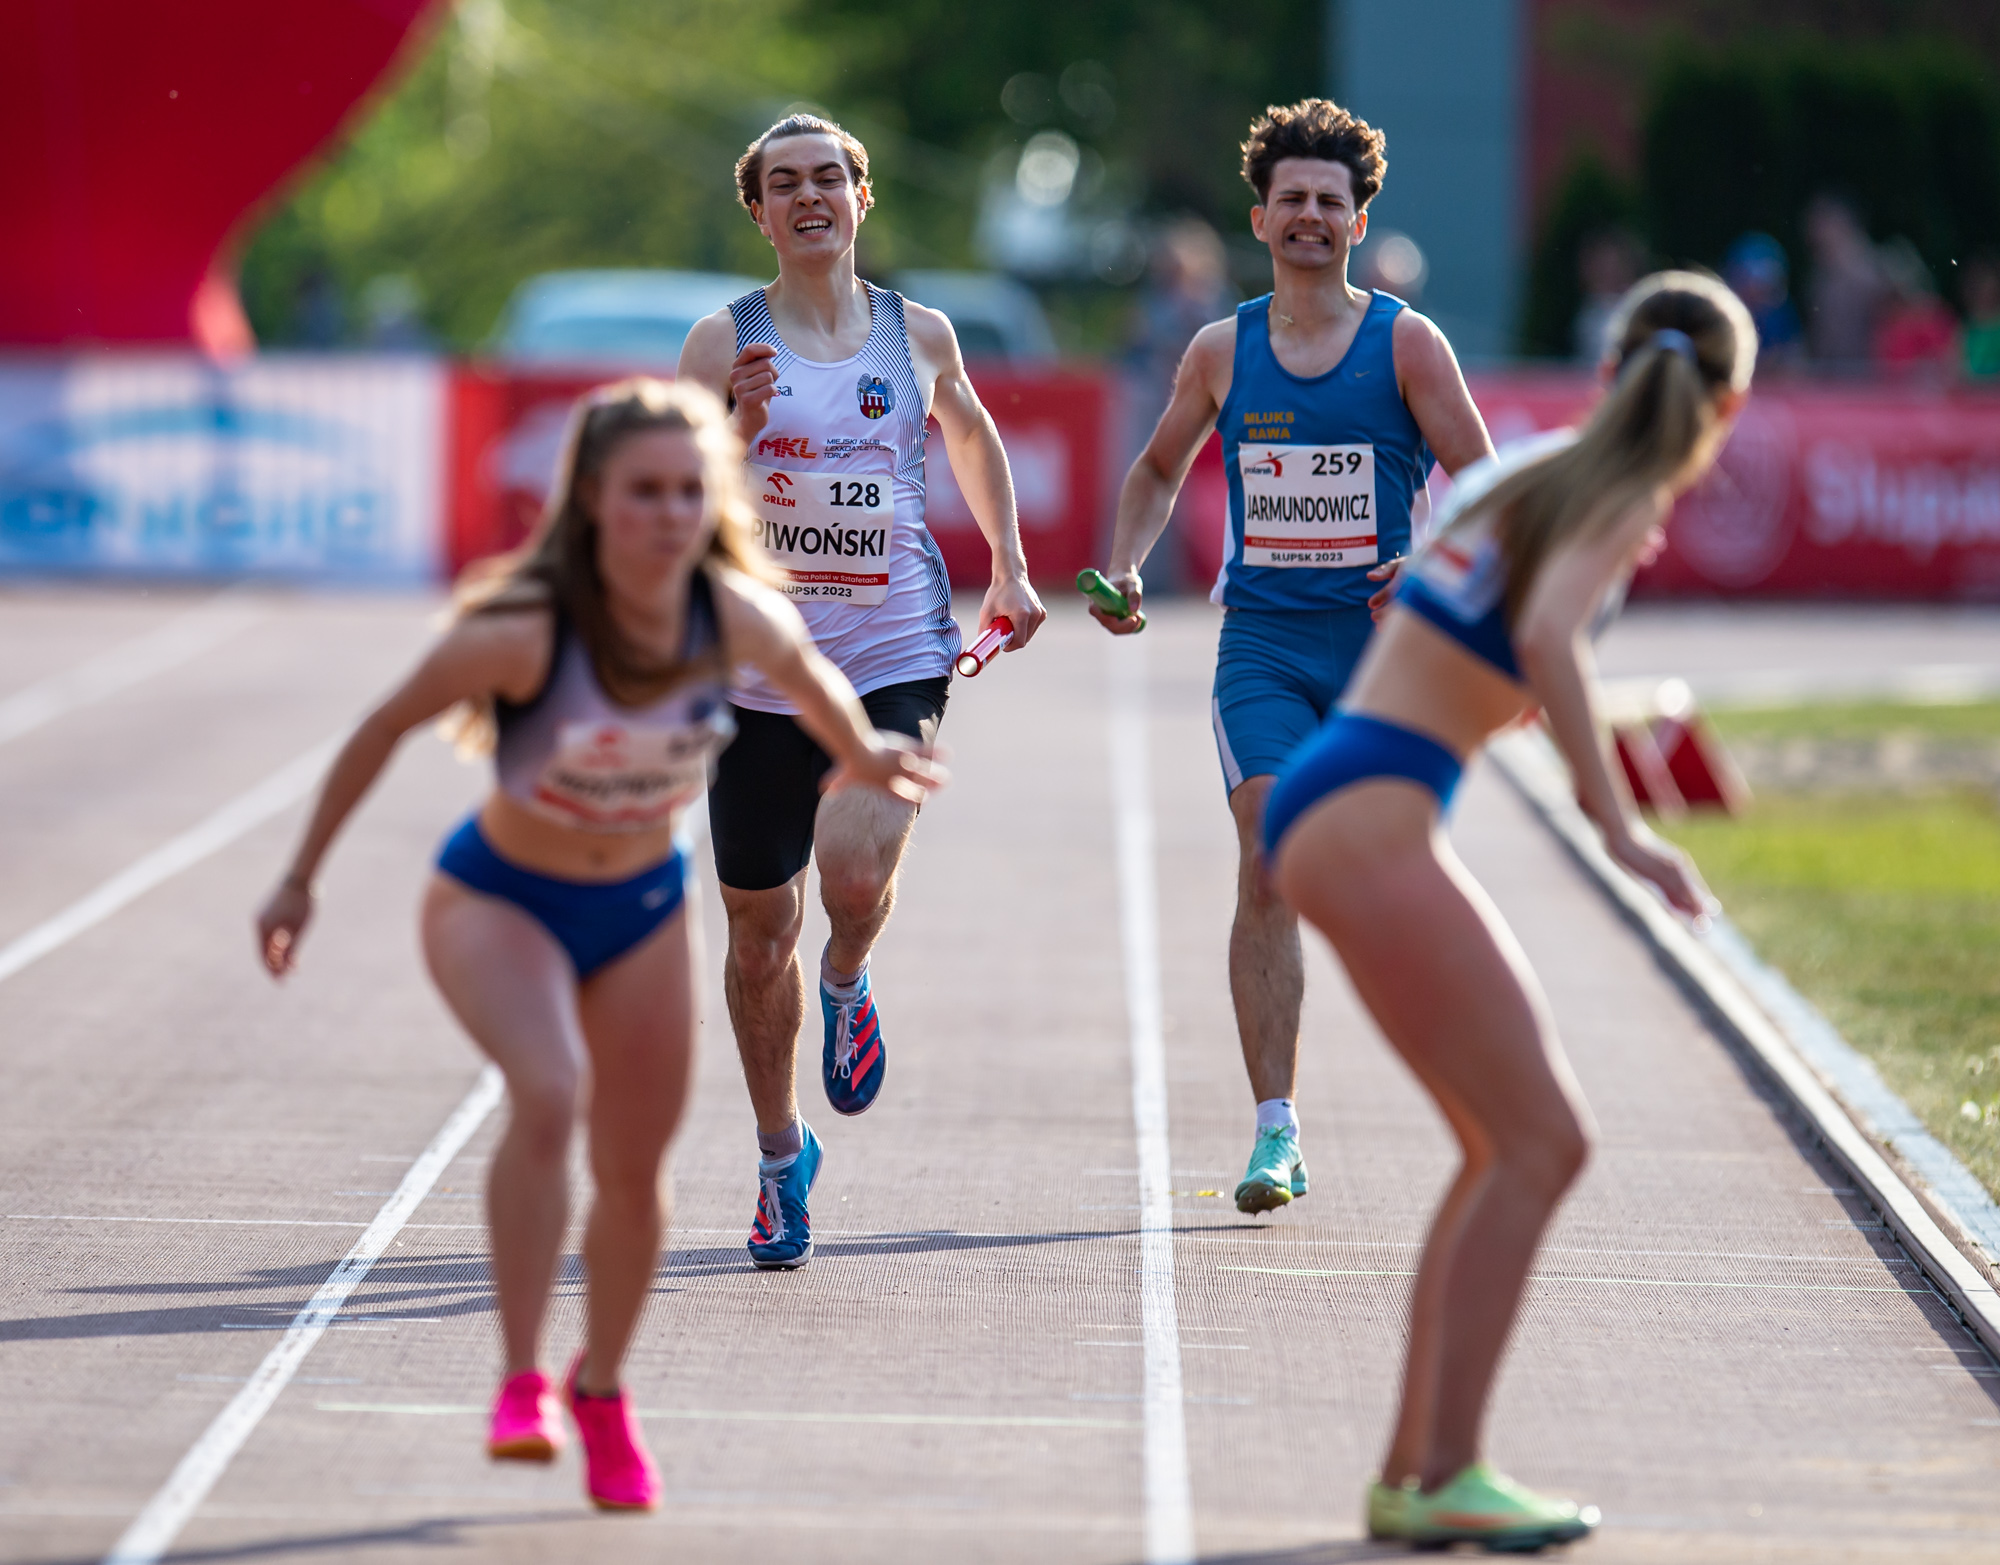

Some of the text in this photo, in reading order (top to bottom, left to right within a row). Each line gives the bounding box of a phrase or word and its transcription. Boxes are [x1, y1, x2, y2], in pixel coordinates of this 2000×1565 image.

[1244, 412, 1295, 425] MLUKS
[1248, 427, 1291, 440] RAWA
[758, 437, 818, 459] MKL
[1311, 452, 1362, 477] 259
[763, 494, 796, 507] ORLEN
[829, 481, 881, 508] 128
[1247, 494, 1370, 522] JARMUNDOWICZ
[750, 517, 885, 557] PIWOŃSKI
[1271, 551, 1343, 562] SŁUPSK 2023
[810, 573, 831, 581] Polski
[840, 575, 879, 584] Sztafetach
[822, 586, 853, 598] 2023
